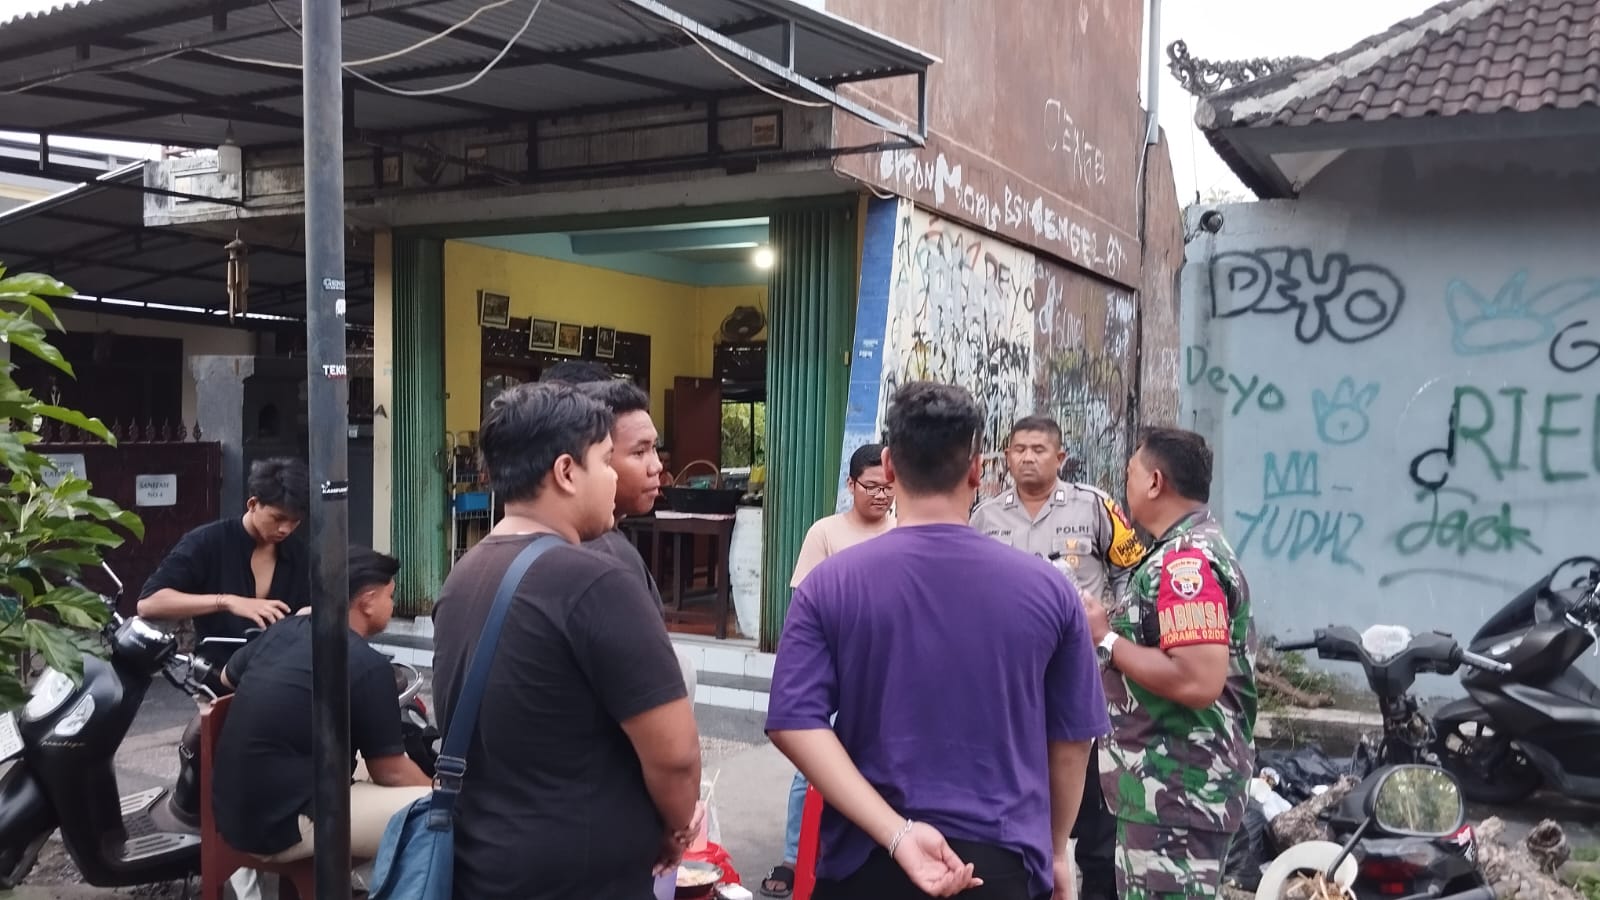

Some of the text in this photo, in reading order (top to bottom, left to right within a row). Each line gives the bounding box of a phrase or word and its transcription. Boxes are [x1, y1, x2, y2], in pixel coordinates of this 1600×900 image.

[1186, 345, 1286, 416] Deyo
[1056, 525, 1089, 534] POLRI
[1163, 629, 1202, 645] KORAMIL
